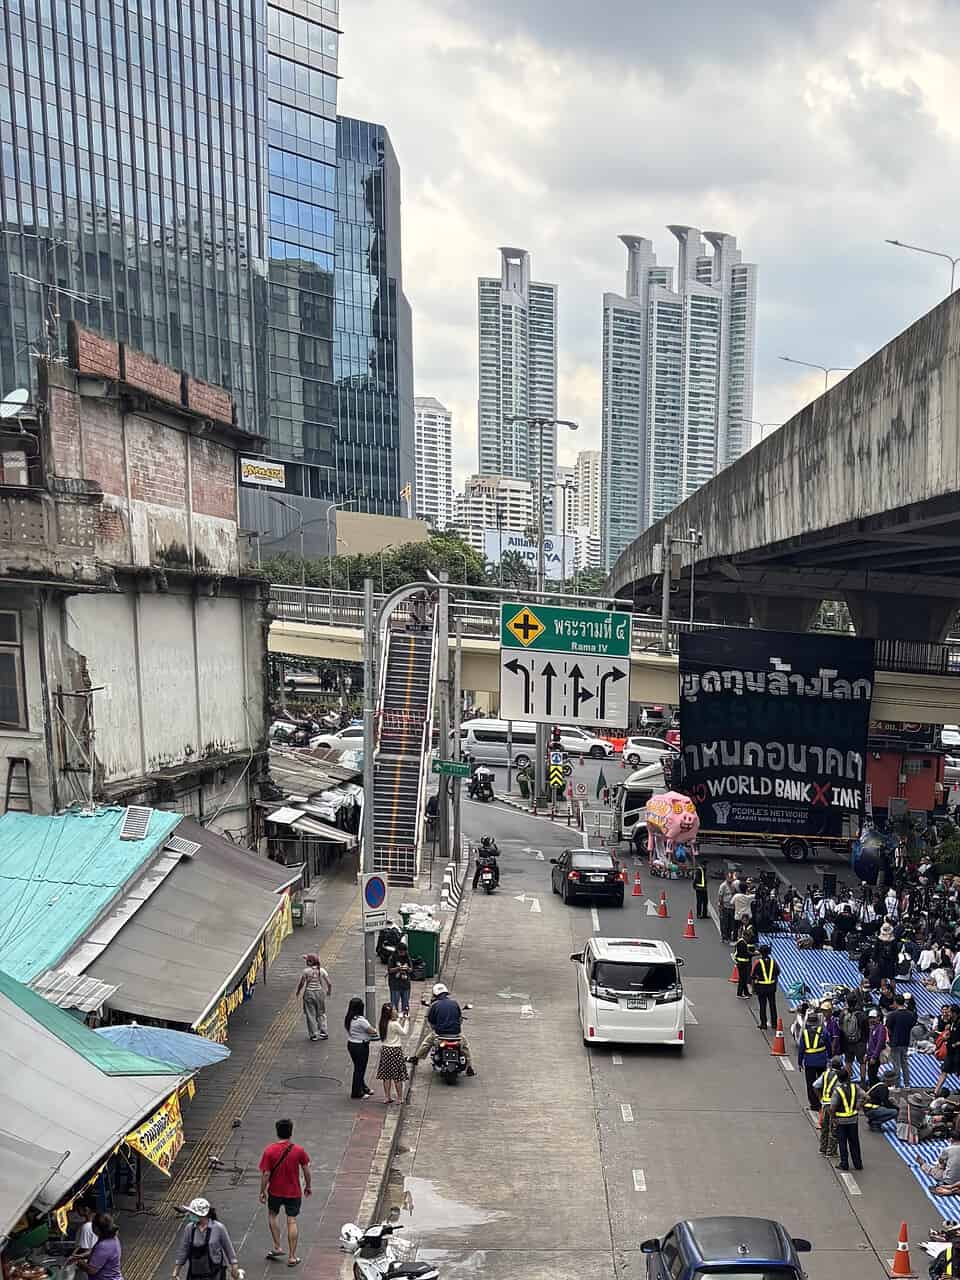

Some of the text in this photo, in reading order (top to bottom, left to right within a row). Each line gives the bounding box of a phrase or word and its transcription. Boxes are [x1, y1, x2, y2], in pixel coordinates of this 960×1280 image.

[508, 537, 540, 548] Allian
[501, 550, 560, 562] AYUDYA
[554, 613, 627, 640] พระรามที่ ๔
[571, 642, 609, 653] Rama IV
[706, 776, 773, 797] WORLD
[775, 779, 813, 802] BANK
[831, 787, 862, 810] IMF
[769, 809, 809, 819] NETWORK
